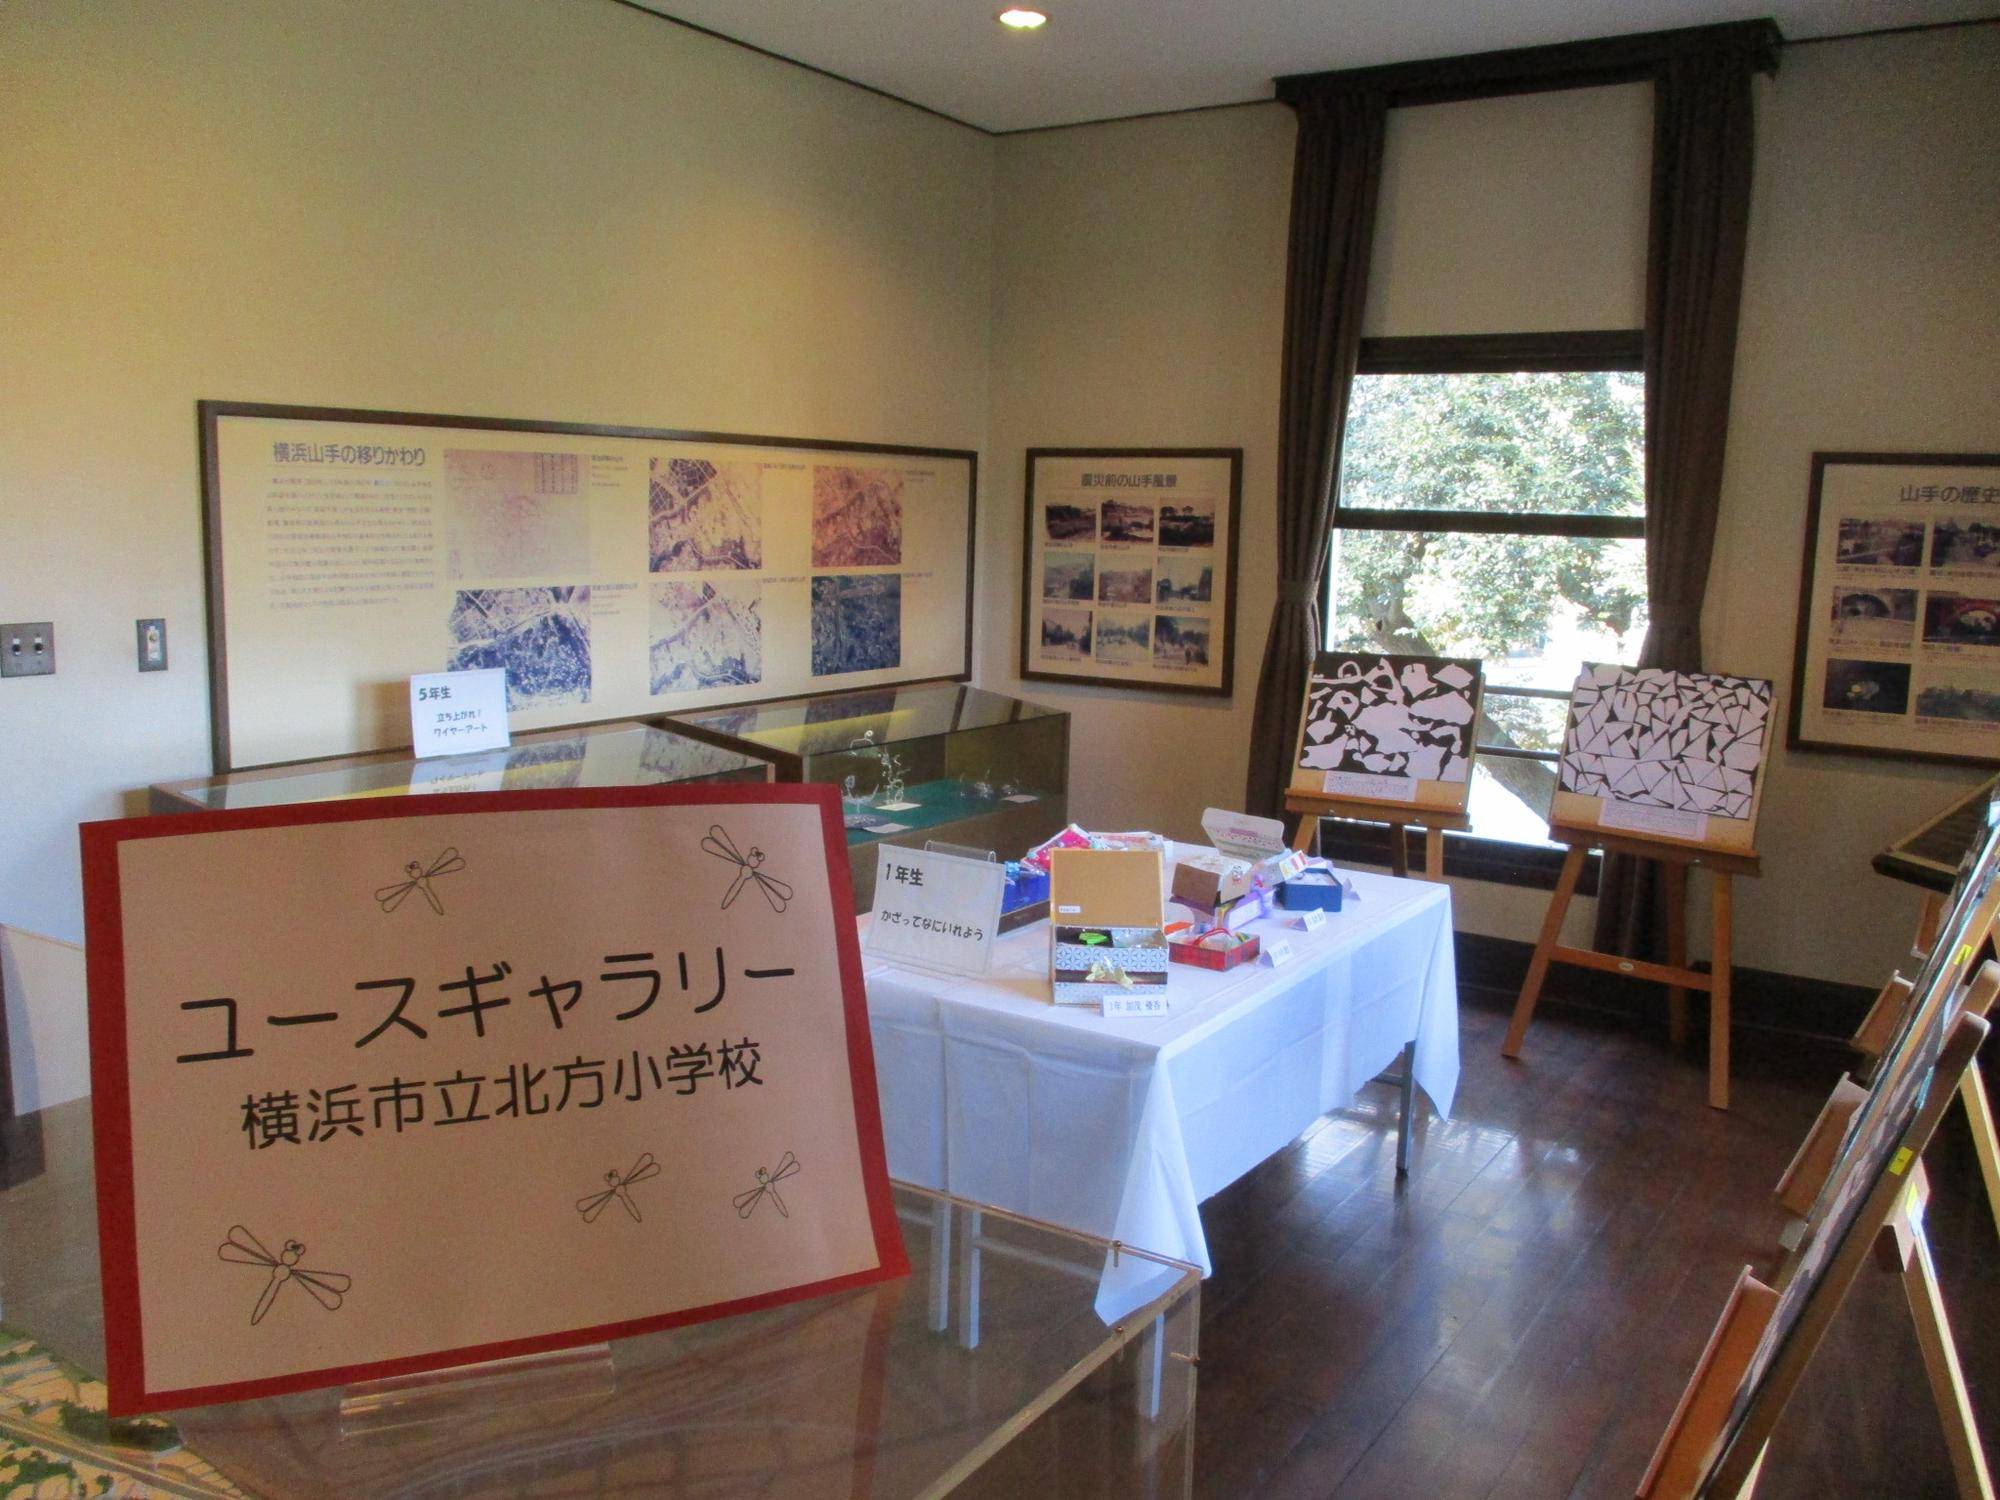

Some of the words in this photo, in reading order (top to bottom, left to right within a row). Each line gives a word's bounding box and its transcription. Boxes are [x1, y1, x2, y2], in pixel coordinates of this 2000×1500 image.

[273, 441, 426, 467] 横浜山手の移りかわり
[418, 685, 452, 702] 5年生
[433, 724, 488, 737] ワイヤーアート
[885, 862, 924, 887] 1年生
[880, 909, 984, 942] かざってなにいれよう
[176, 946, 796, 1065] ユースギャラリー
[240, 1036, 764, 1151] 横浜市立北方小学校
